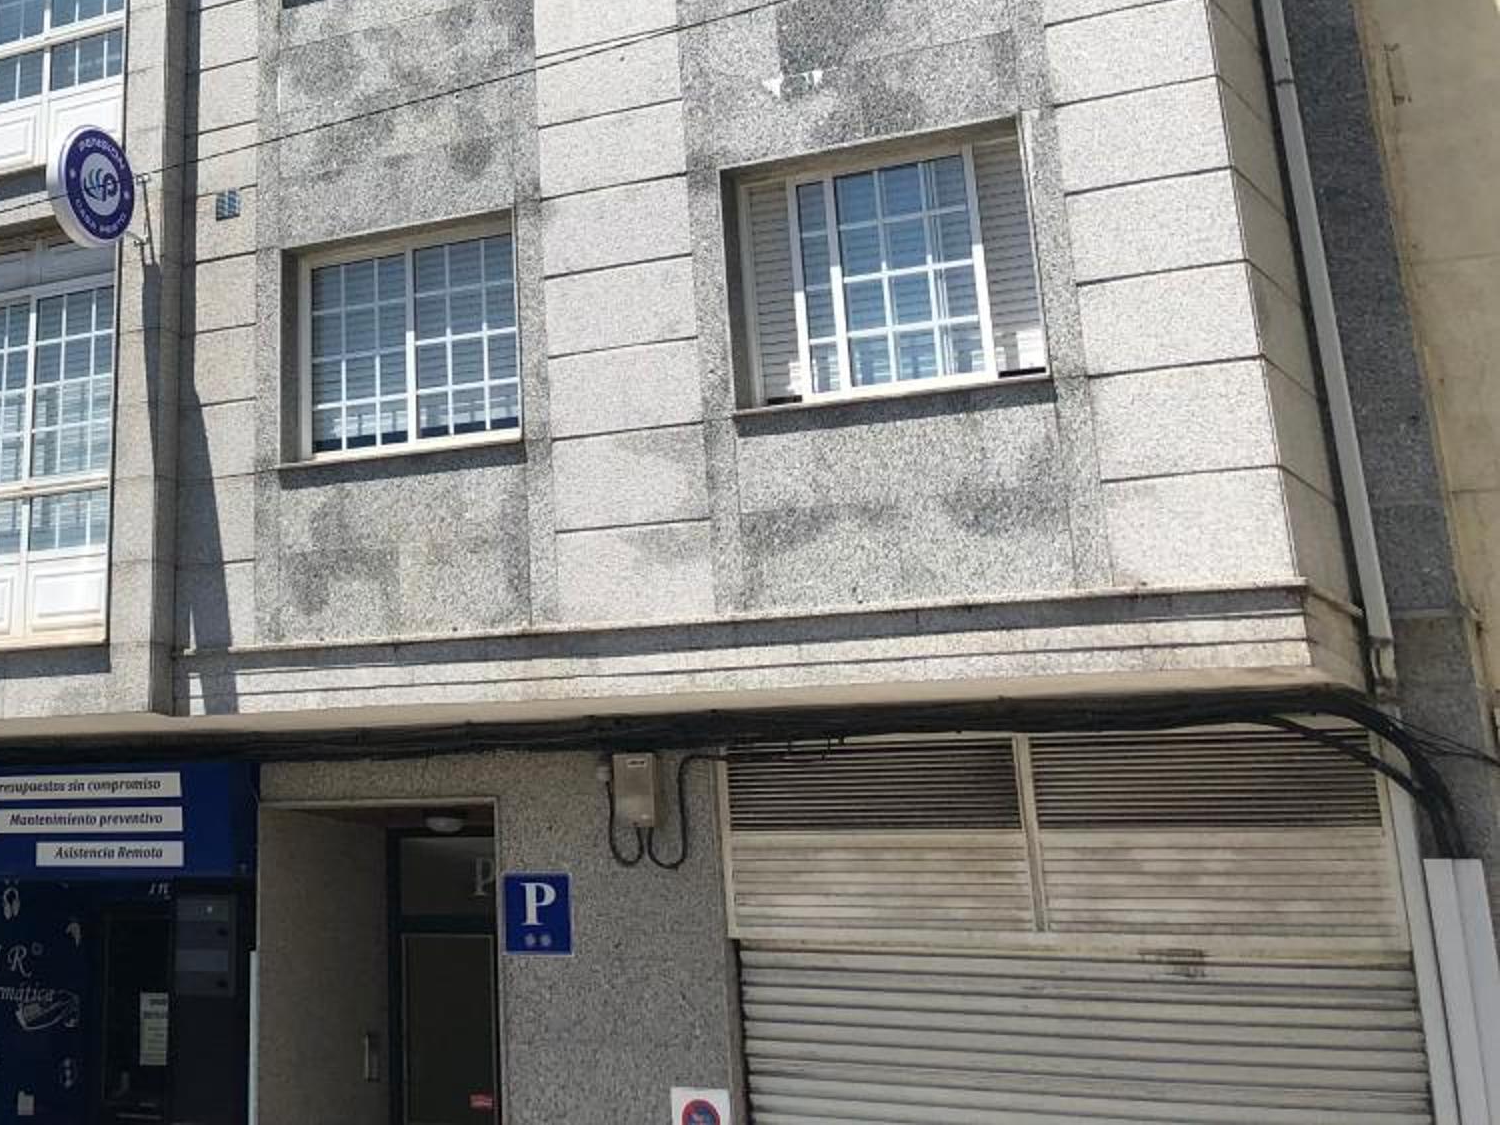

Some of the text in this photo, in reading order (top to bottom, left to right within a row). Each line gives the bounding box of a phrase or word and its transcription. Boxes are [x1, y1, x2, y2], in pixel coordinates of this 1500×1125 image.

[67, 779, 85, 792] sin
[87, 778, 161, 794] compromiso
[9, 812, 163, 827] Mantenimiento preventivo
[54, 846, 163, 860] Asistencia Remota
[520, 881, 557, 926] P
